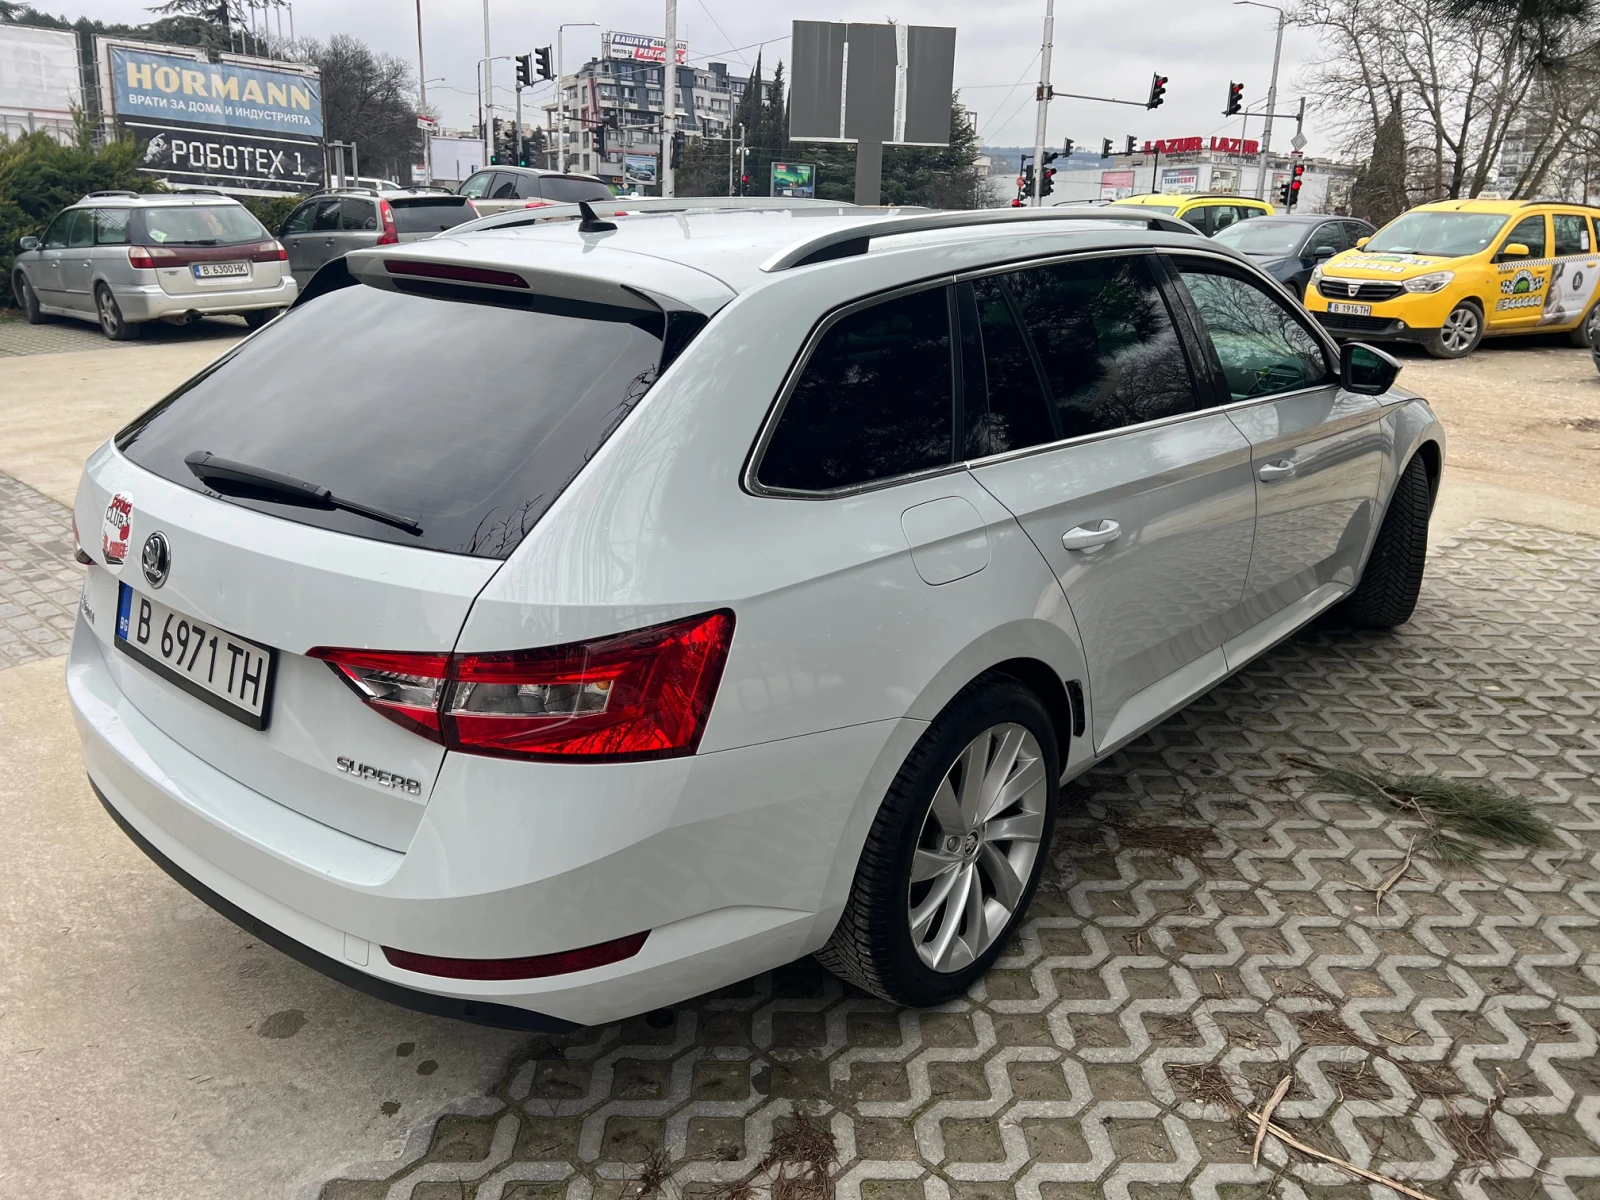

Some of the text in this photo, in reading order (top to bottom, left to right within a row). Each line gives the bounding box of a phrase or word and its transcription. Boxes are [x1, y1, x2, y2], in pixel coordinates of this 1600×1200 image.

[614, 34, 648, 46] ВАШАТА
[638, 48, 679, 60] РЕКЛАА
[126, 61, 310, 111] HÖRMANN
[129, 94, 311, 126] ВРАТИ ЗА ДОМА И ИНДУСТРИЯТА
[1144, 136, 1203, 155] LAZUR
[1210, 136, 1259, 155] LAZUR
[171, 139, 306, 176] РОБОТЕХ 1
[213, 264, 234, 274] 6300
[234, 264, 246, 273] HK
[1334, 303, 1369, 314] B 1916 TH
[106, 506, 124, 529] CLUB
[119, 616, 129, 632] BG
[136, 598, 151, 645] B
[161, 613, 218, 683] 6971
[227, 642, 263, 706] TH
[336, 755, 421, 796] SUPERB
